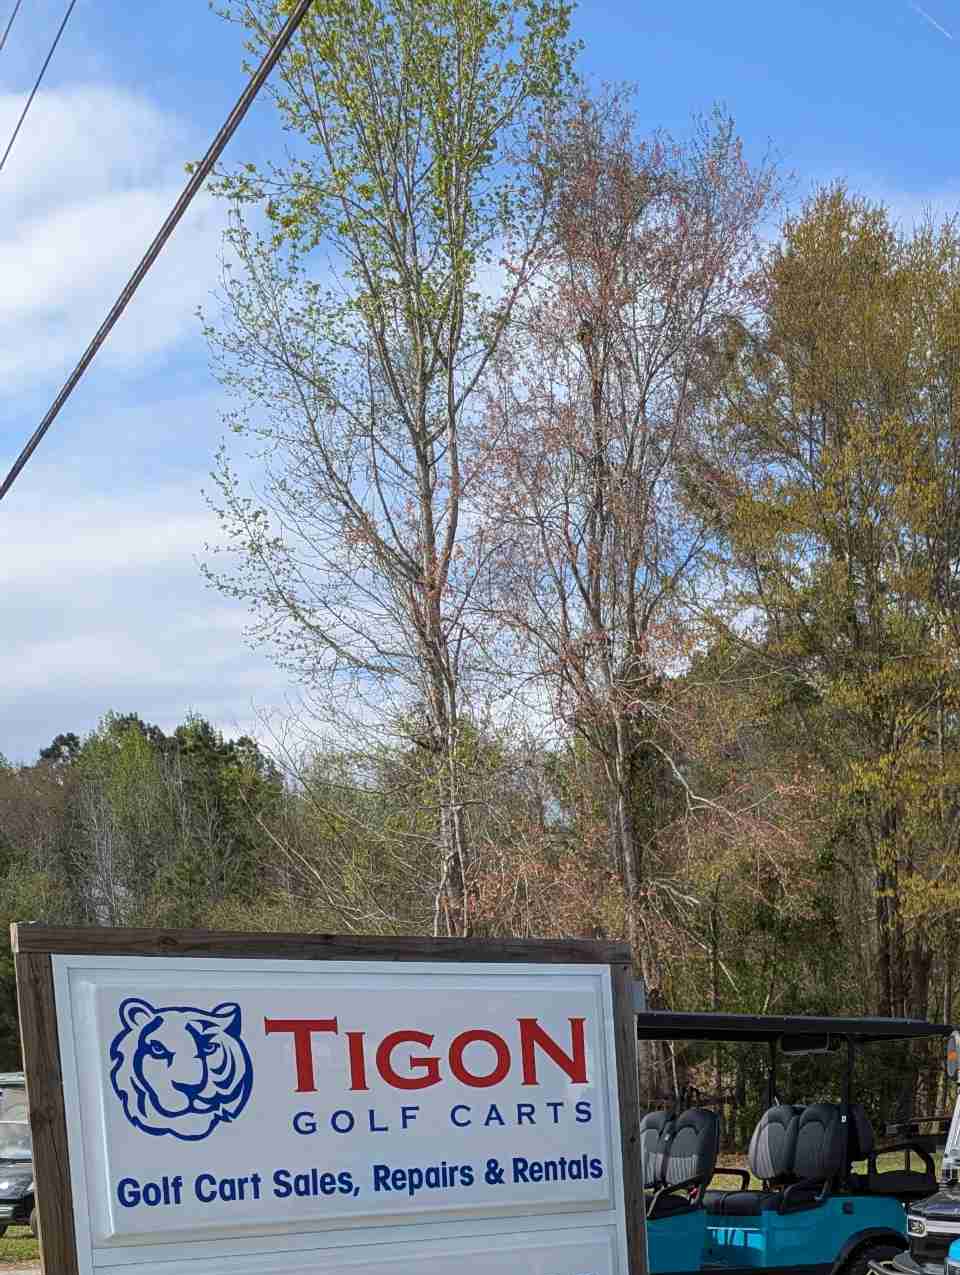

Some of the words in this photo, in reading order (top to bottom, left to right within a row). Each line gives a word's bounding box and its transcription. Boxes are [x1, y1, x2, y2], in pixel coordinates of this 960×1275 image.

[263, 1016, 590, 1093] TIGON
[292, 1105, 421, 1136] GOLF
[450, 1101, 593, 1129] CARTS
[116, 1174, 183, 1208] Golf
[194, 1171, 261, 1203] Cart
[272, 1165, 361, 1199] Sales,
[373, 1161, 475, 1198] Repairs
[484, 1158, 506, 1185] &
[512, 1153, 604, 1184] Rentals
